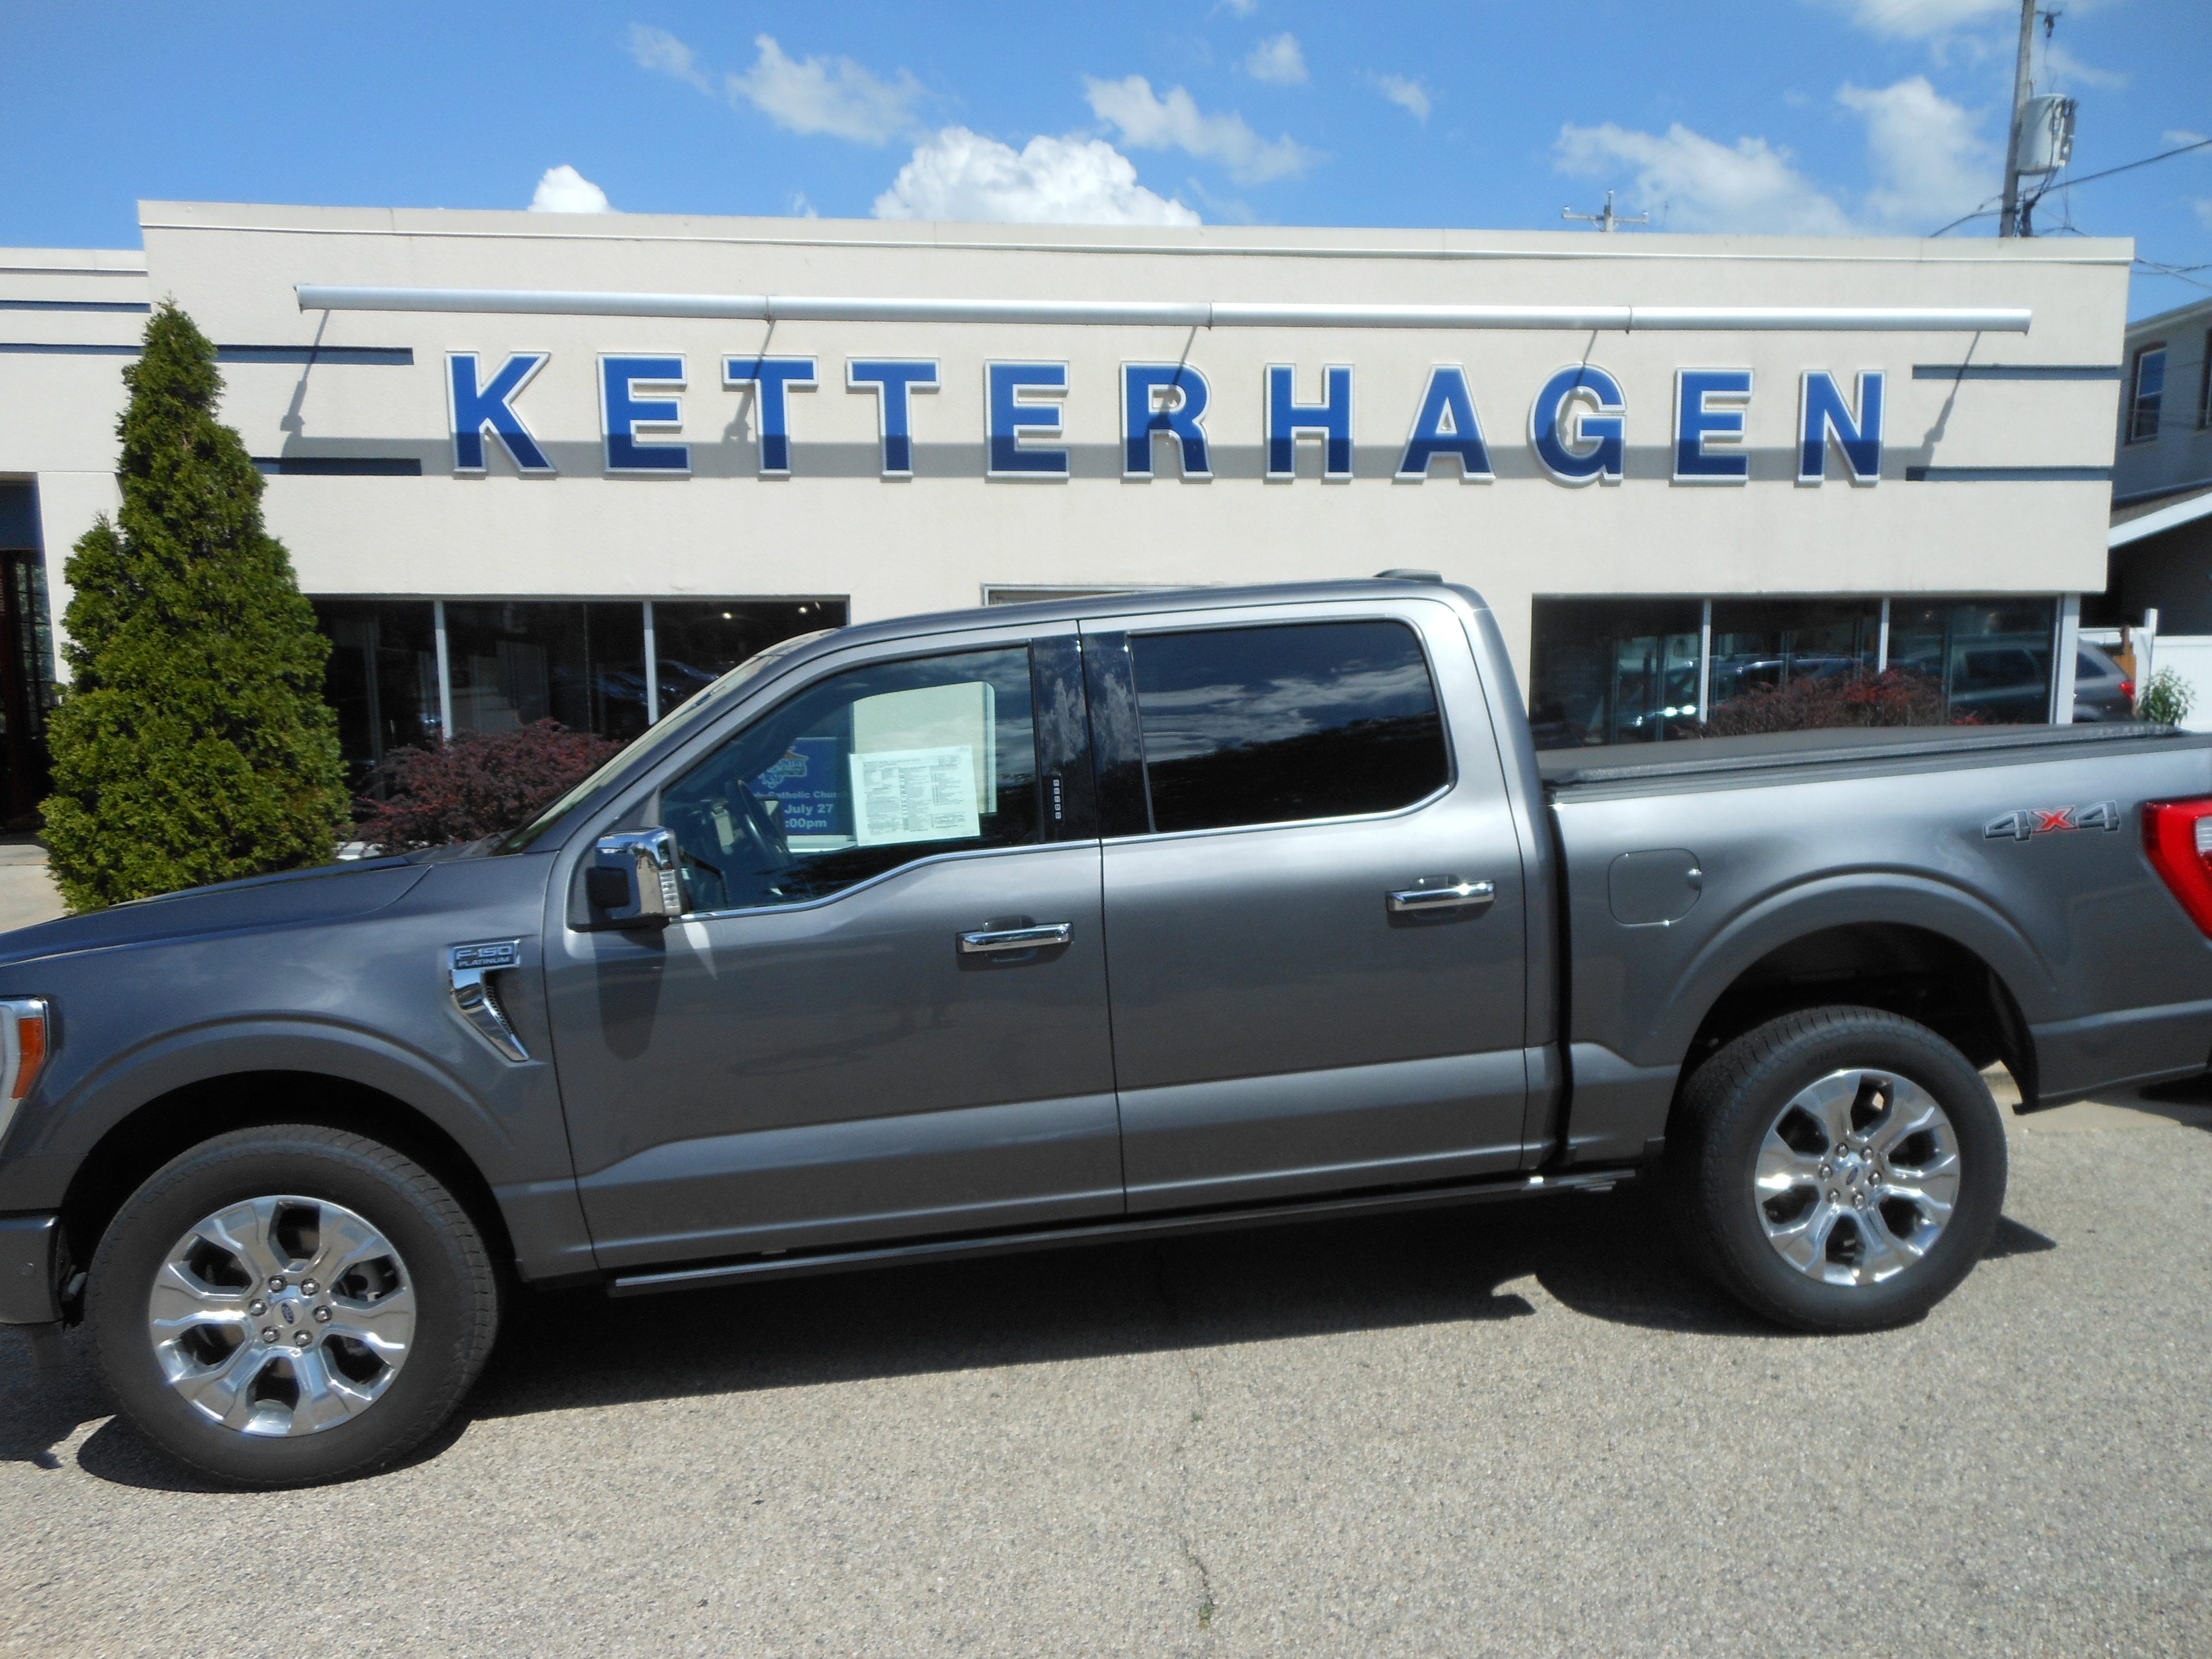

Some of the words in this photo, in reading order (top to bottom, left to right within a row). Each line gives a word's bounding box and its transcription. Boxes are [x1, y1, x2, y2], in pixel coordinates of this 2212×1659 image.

[445, 350, 1887, 482] KETTERHAGEN
[784, 804, 813, 816] July
[817, 804, 834, 813] 27
[785, 818, 827, 830] :00pm
[457, 946, 512, 959] F-150
[459, 957, 509, 966] PLATINUM
